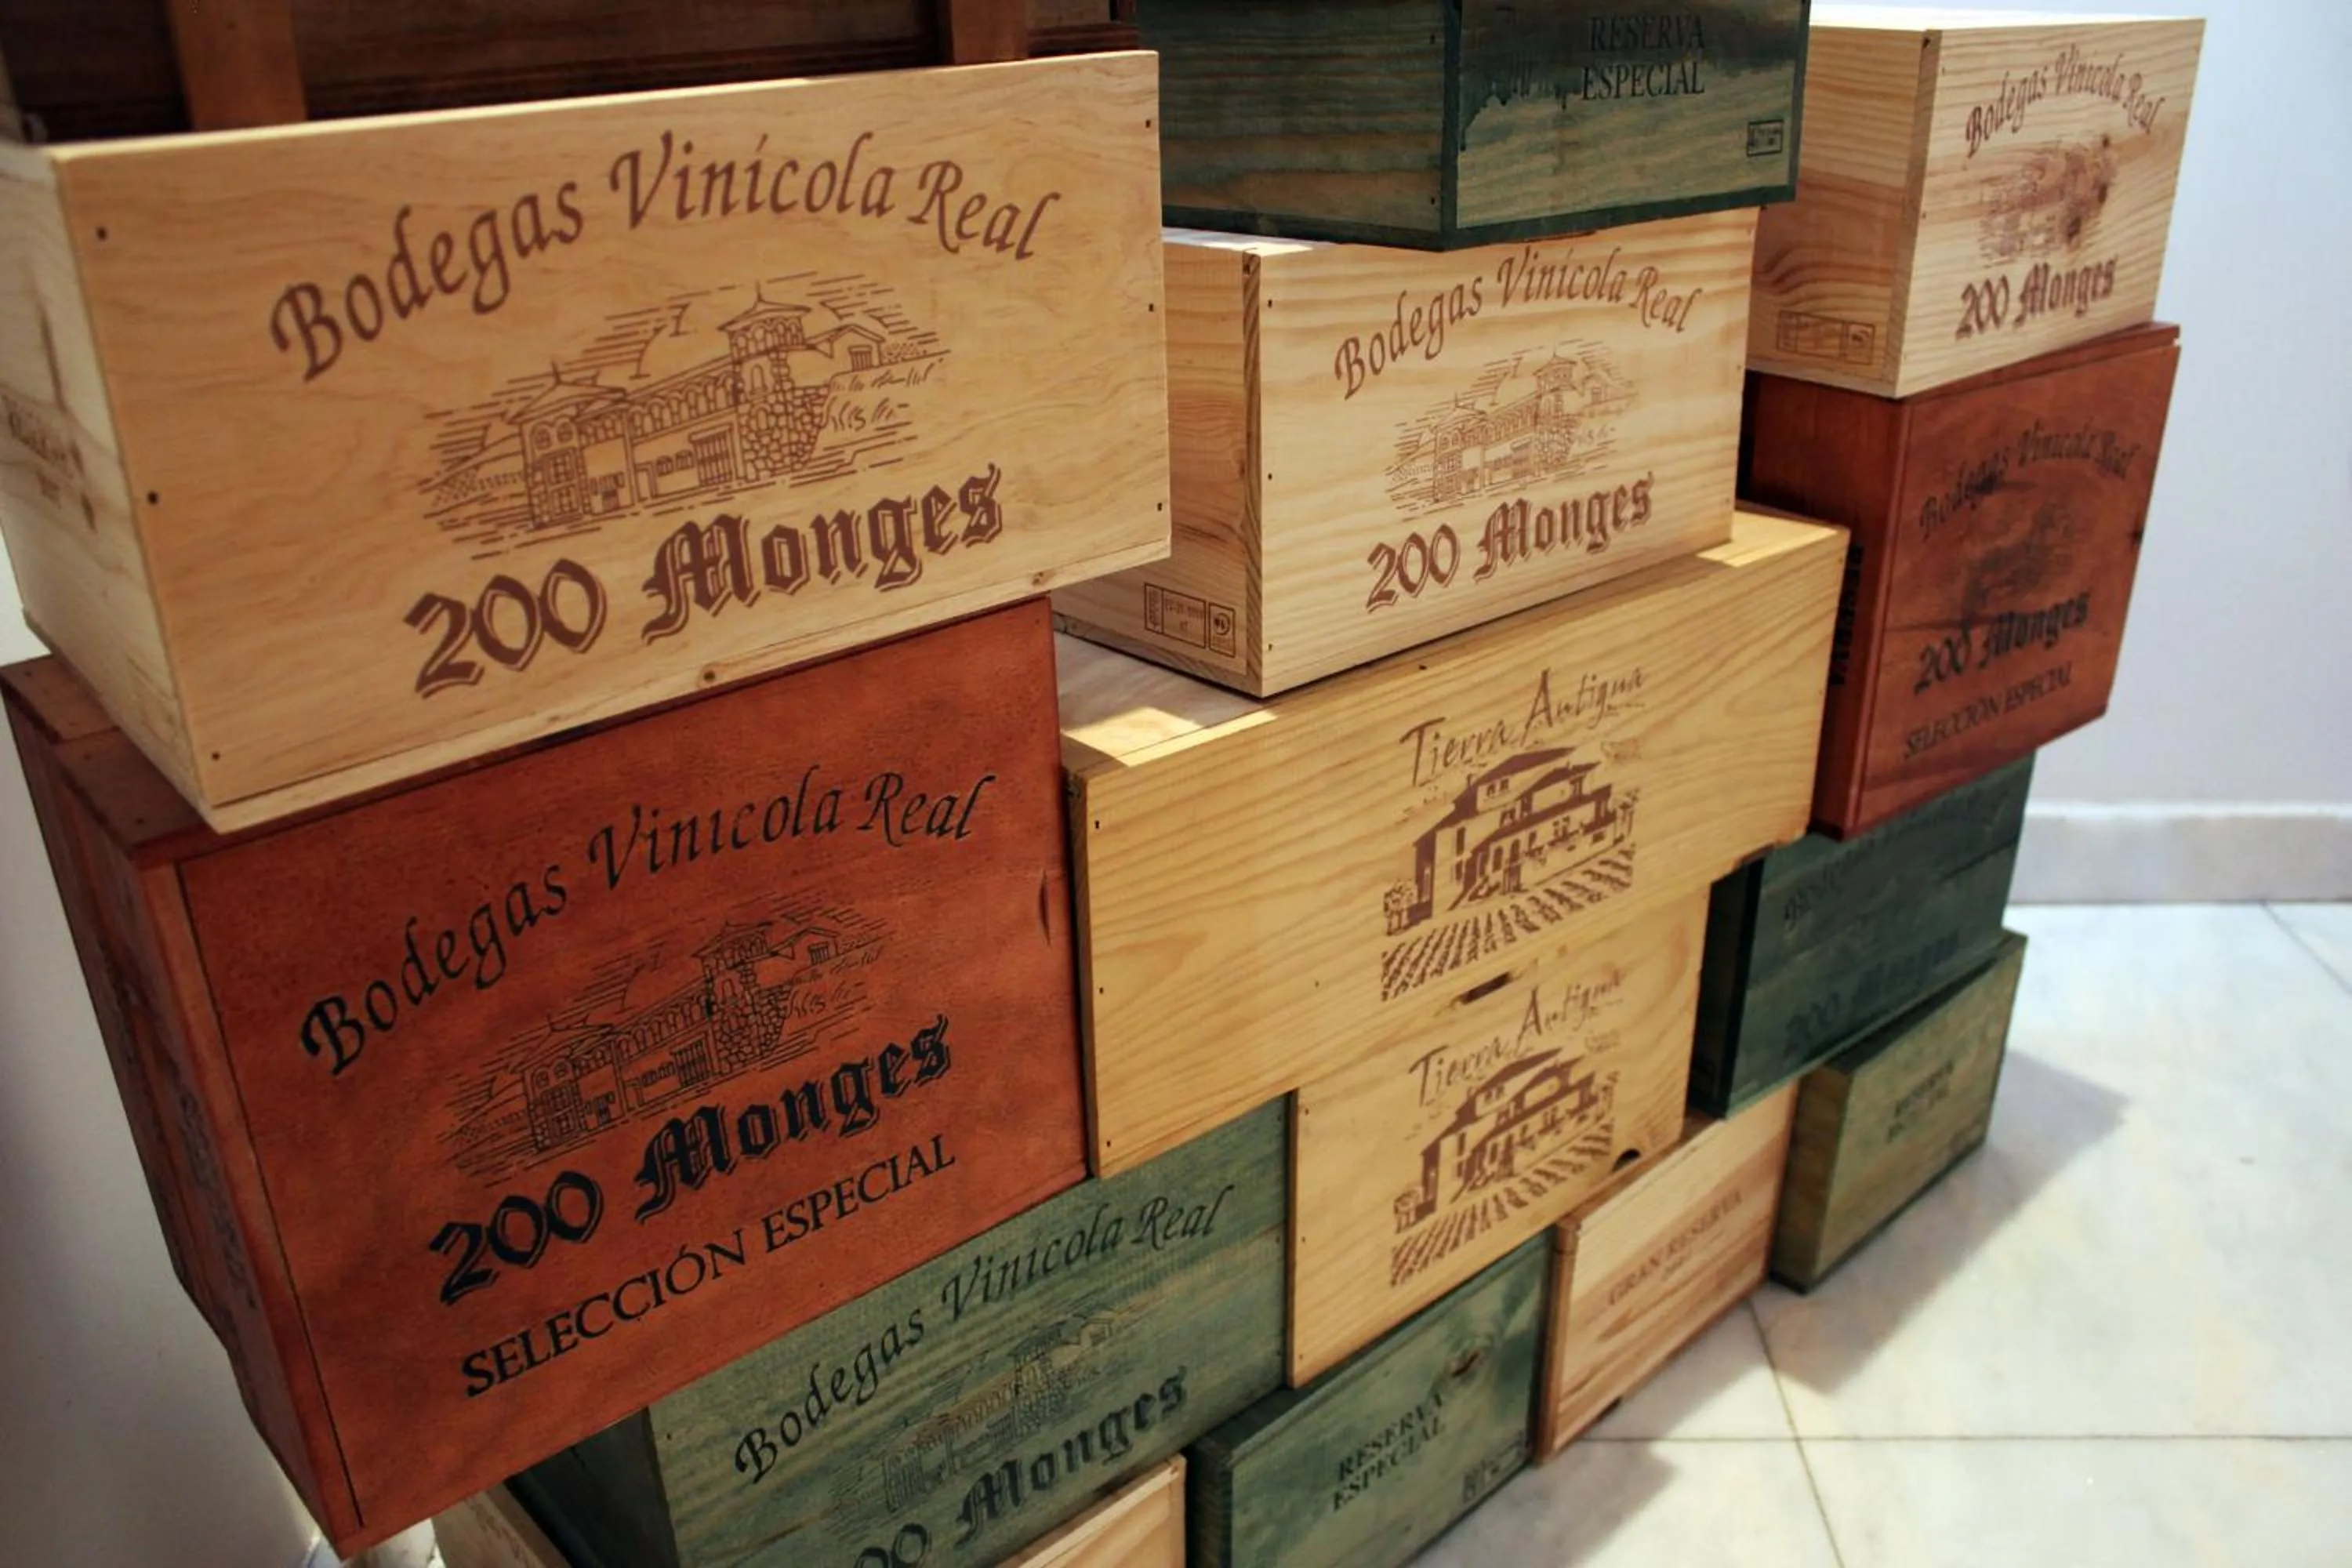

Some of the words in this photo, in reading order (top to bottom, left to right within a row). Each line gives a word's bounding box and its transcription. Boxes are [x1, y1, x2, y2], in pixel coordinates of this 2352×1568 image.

[1581, 61, 1705, 101] ESPECIAL
[1590, 13, 1706, 52] RESERVA
[1965, 66, 2048, 158] Bodegas
[269, 180, 585, 382] Bodegas
[610, 130, 895, 230] Vinícola
[909, 159, 1060, 260] Real
[1955, 274, 2009, 341] 200
[2013, 256, 2118, 328] Monges
[1334, 275, 1483, 401] Bodegas
[1628, 265, 1703, 333] Real
[404, 557, 608, 699] 200
[641, 463, 1003, 644] Monges
[1366, 523, 1461, 614] 200
[1473, 471, 1657, 583] Monges
[1399, 716, 1511, 787] Tierra
[1522, 667, 1646, 746] Antigua
[300, 863, 567, 1076] Bodegas
[858, 771, 996, 848] Real
[1409, 1044, 1508, 1108] Tierra
[429, 1170, 603, 1306] 200
[633, 1014, 953, 1221] Monges
[461, 1231, 746, 1398] SELECCIÓN
[762, 1134, 956, 1253] ESPECIAL
[735, 1308, 925, 1483] Bodegas
[1129, 1185, 1234, 1250] Real
[954, 1365, 1189, 1549] Monges
